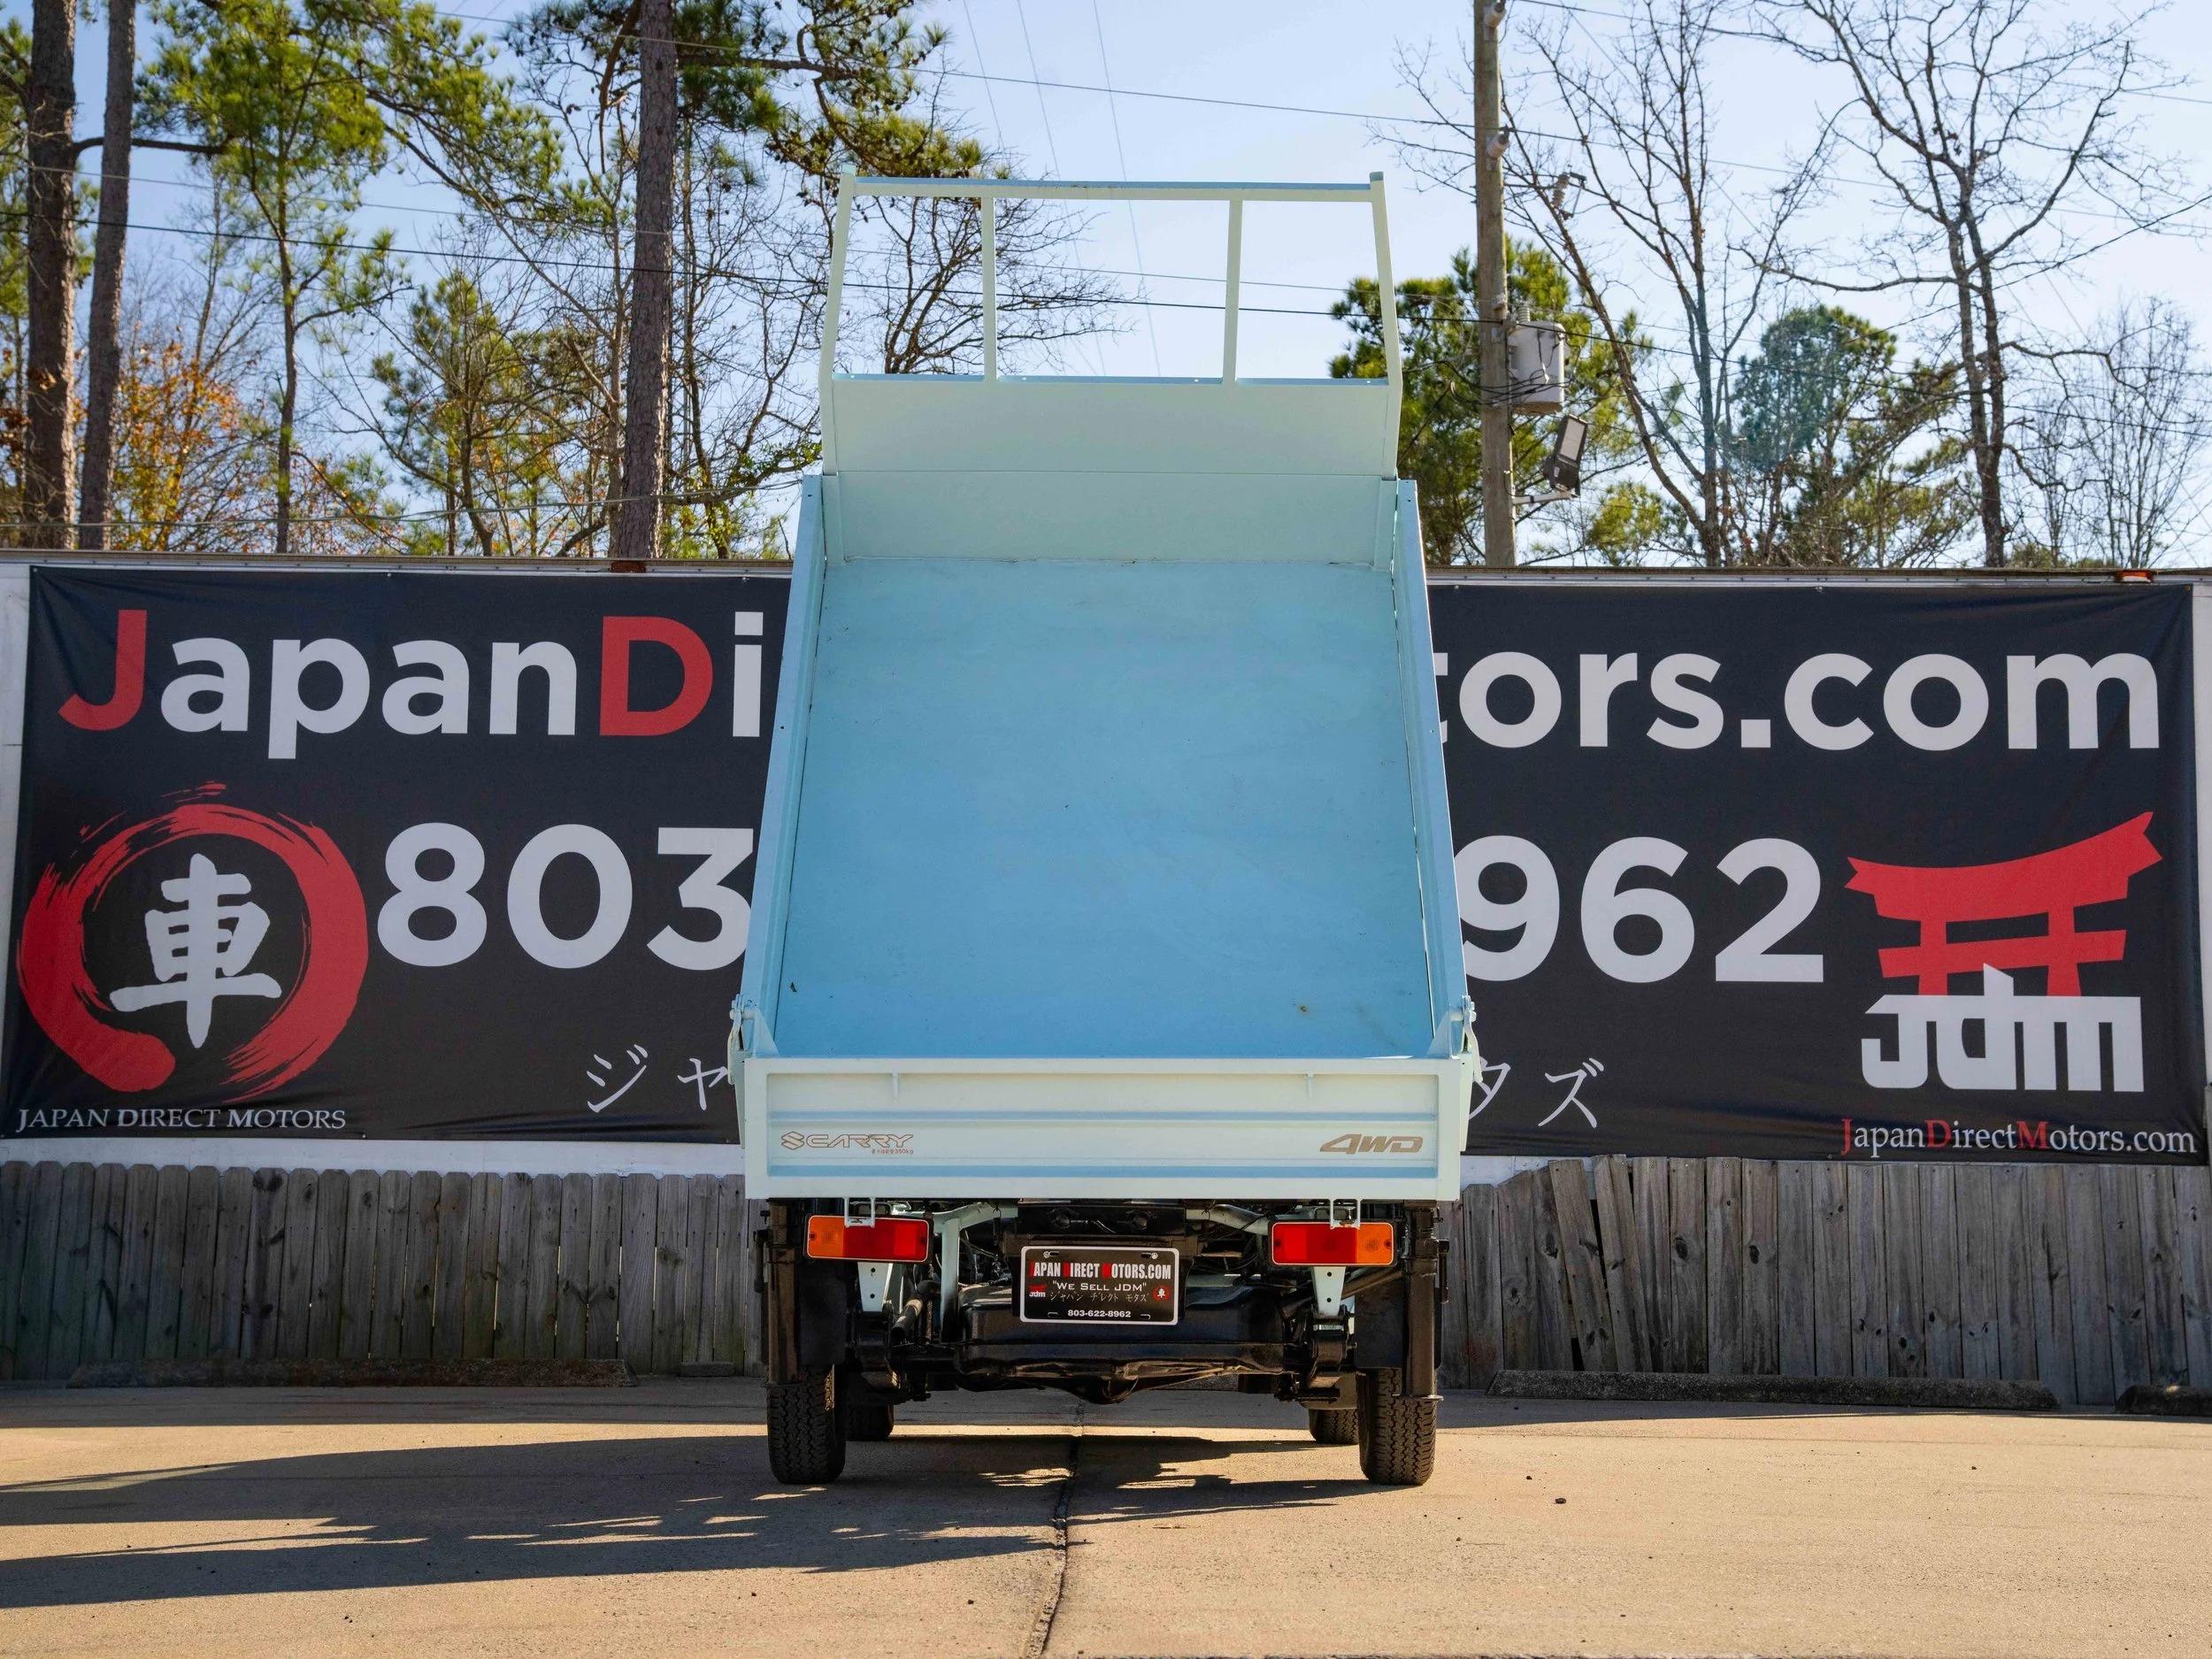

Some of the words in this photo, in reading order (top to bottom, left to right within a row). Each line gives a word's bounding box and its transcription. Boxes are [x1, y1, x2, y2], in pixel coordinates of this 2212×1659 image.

[377, 822, 753, 971] 803
[1454, 834, 1824, 984] 962
[111, 854, 281, 1048] 車
[16, 1109, 109, 1133] JAPAN
[116, 1109, 221, 1128] DIRECT
[227, 1109, 346, 1129] MOTORS
[1320, 1133, 1424, 1155] 4WD
[1841, 1118, 2197, 1157] JapanDirectMotors.com
[1029, 1260, 1061, 1278] JAPAN
[1067, 1310, 1132, 1318] 803-622-8962
